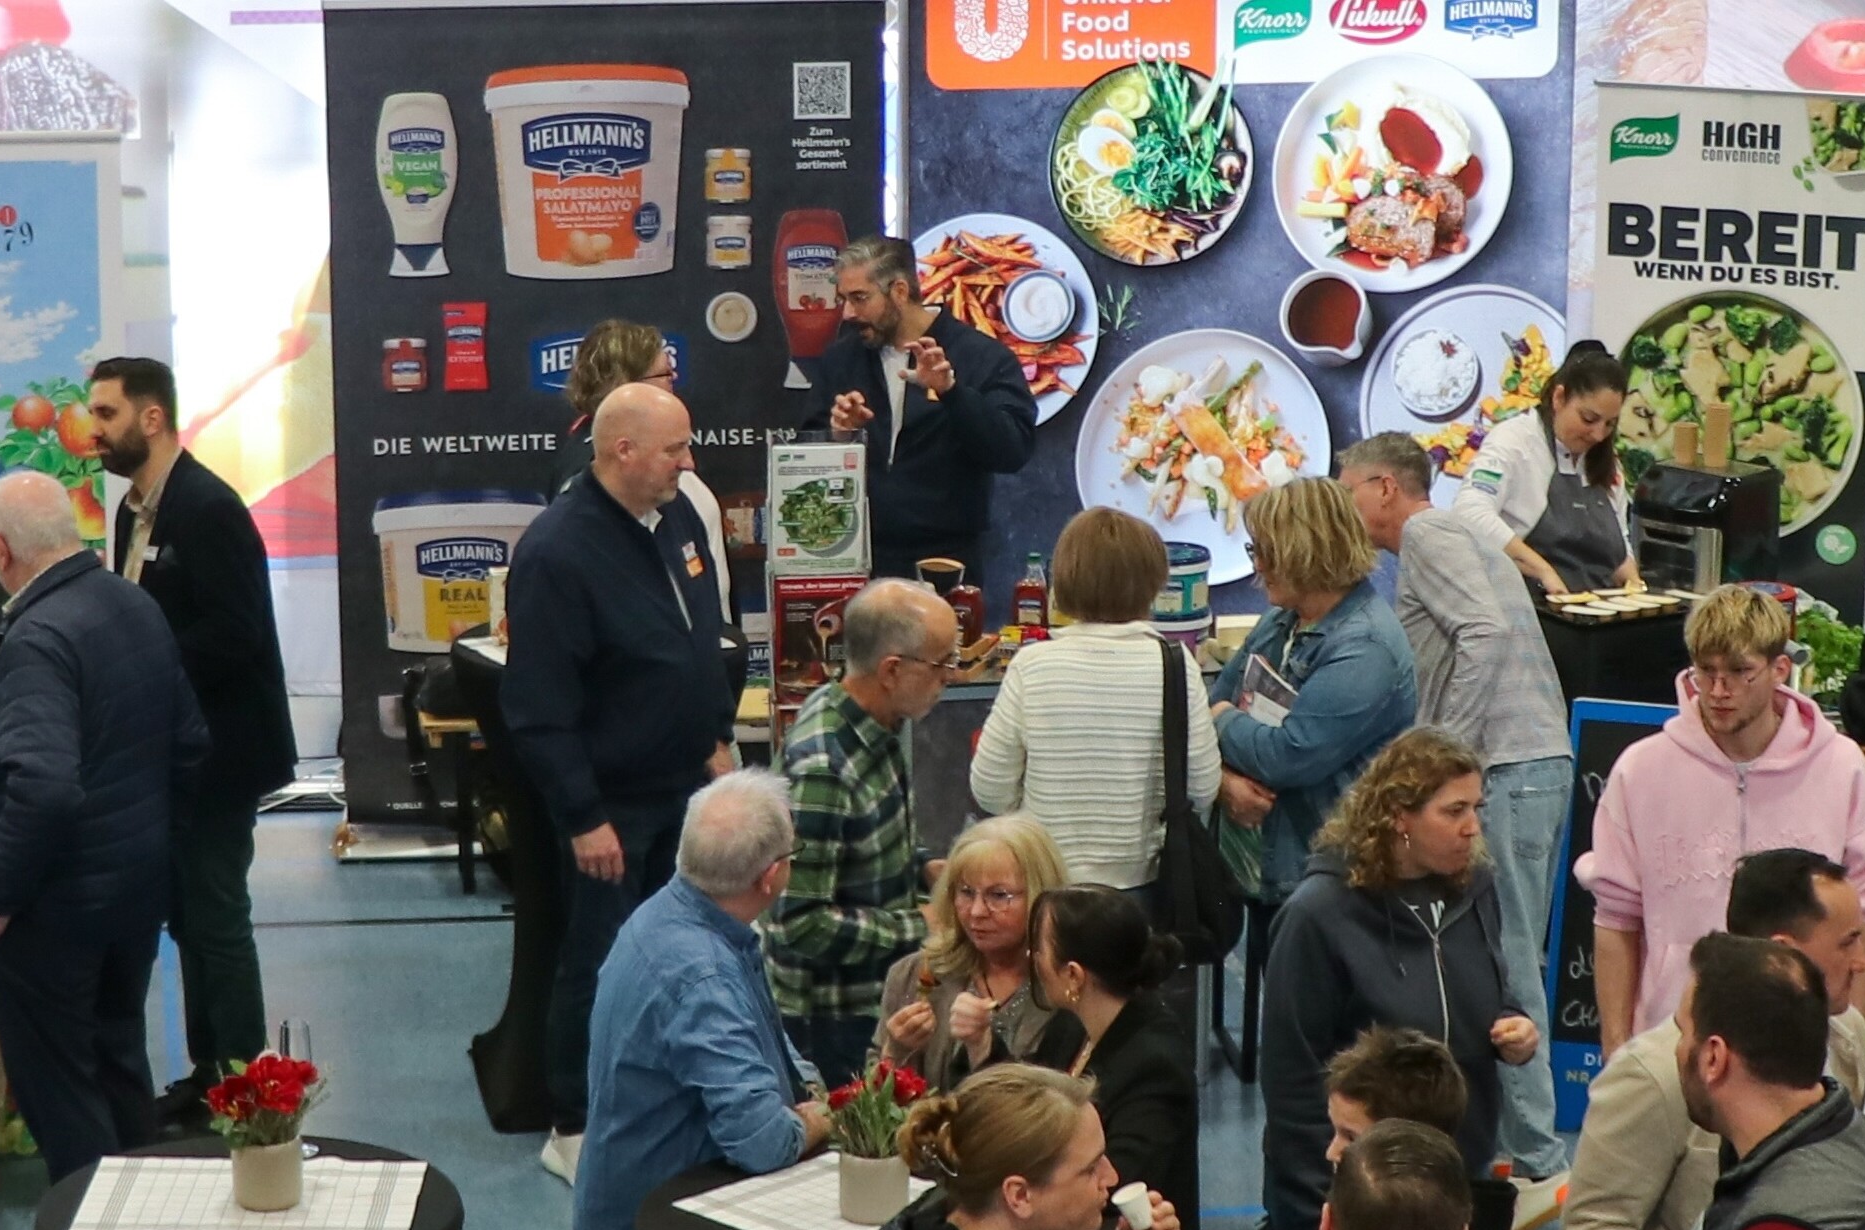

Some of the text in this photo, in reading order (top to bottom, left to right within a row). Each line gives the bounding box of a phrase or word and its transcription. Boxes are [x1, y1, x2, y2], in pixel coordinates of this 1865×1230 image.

[1061, 10, 1129, 33] Food
[1237, 8, 1310, 28] Knorr
[1061, 38, 1191, 61] Solutions
[528, 122, 645, 152] HELLMANN'S
[809, 127, 833, 136] Zum
[1614, 125, 1674, 147] Knorr
[792, 138, 851, 148] Hellmann's
[796, 160, 847, 170] sortiment
[535, 186, 639, 200] PROFESSIONAL
[1634, 261, 1839, 290] WENN DU ES BIST.
[373, 437, 412, 456] DIE
[421, 433, 557, 453] WELTWEITE
[421, 544, 504, 565] HELLMANN'S
[440, 588, 487, 602] REAL
